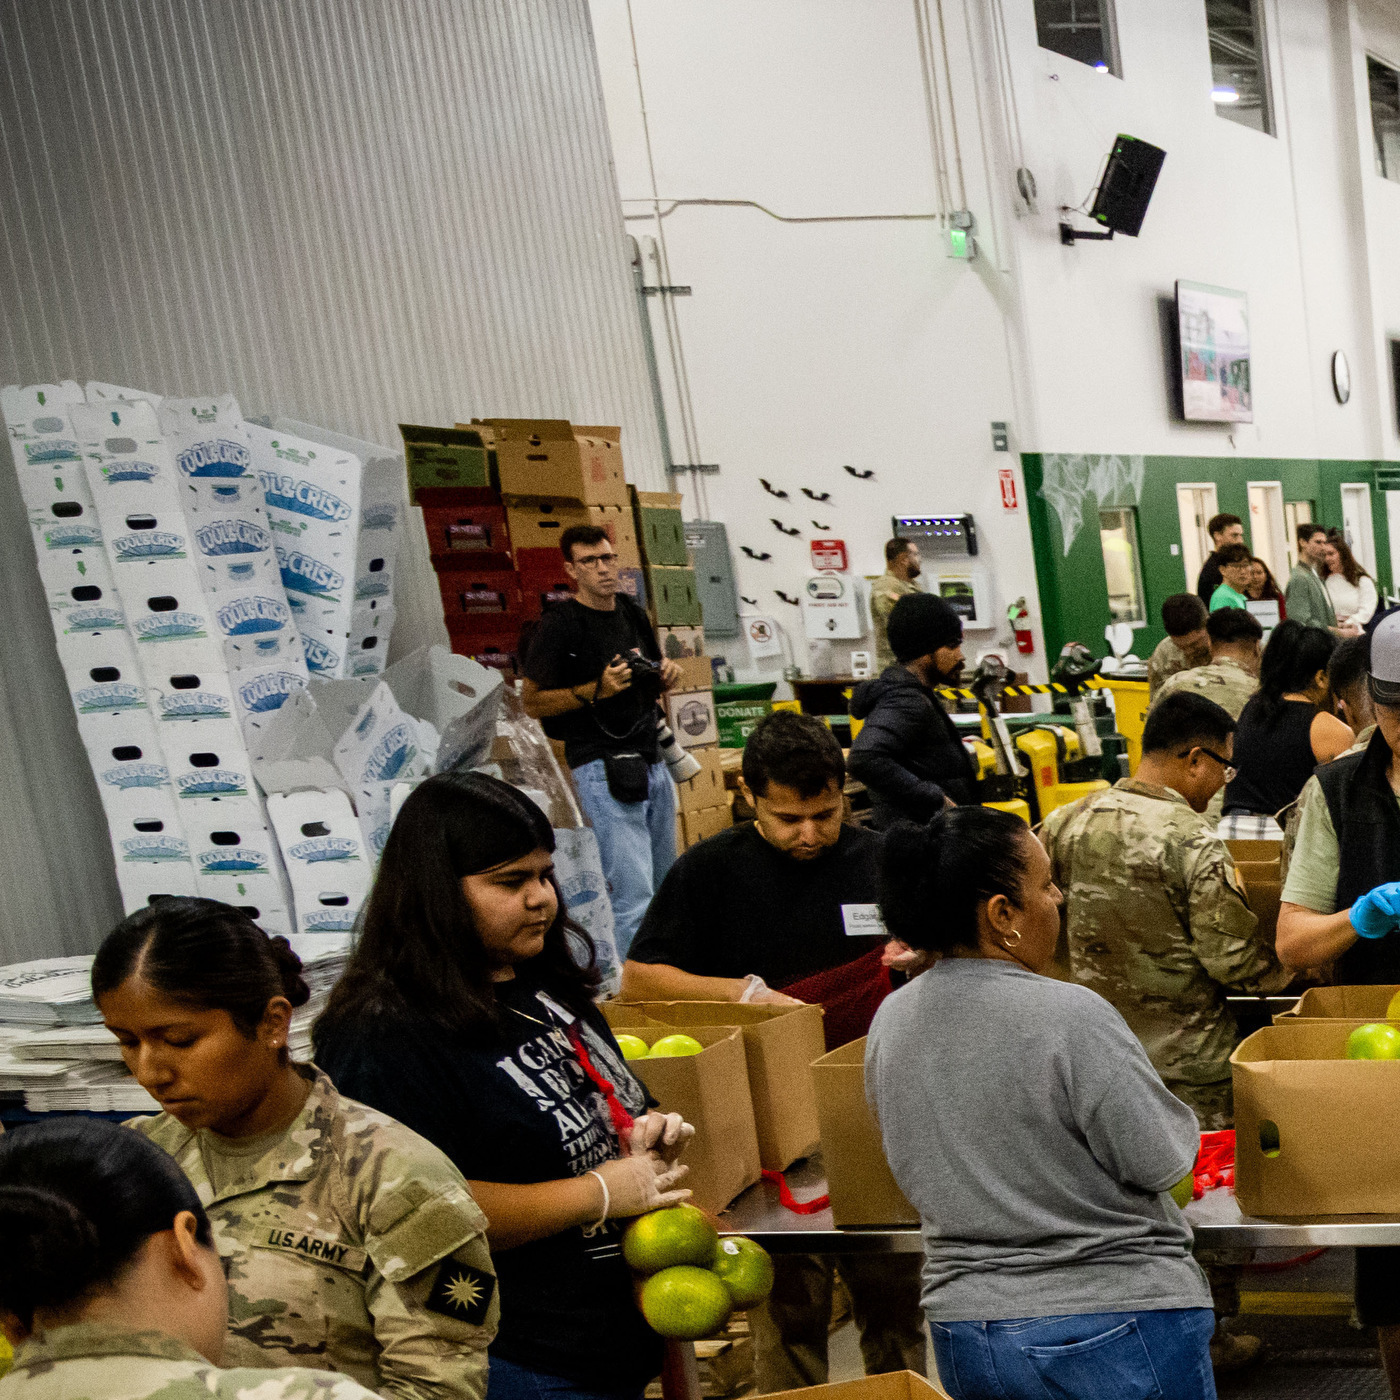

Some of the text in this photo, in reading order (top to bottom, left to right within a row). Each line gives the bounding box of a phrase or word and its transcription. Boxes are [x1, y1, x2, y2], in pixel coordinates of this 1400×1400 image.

[717, 706, 765, 717] DONATE
[519, 1027, 577, 1071] CAN
[295, 1235, 349, 1262] ARMY
